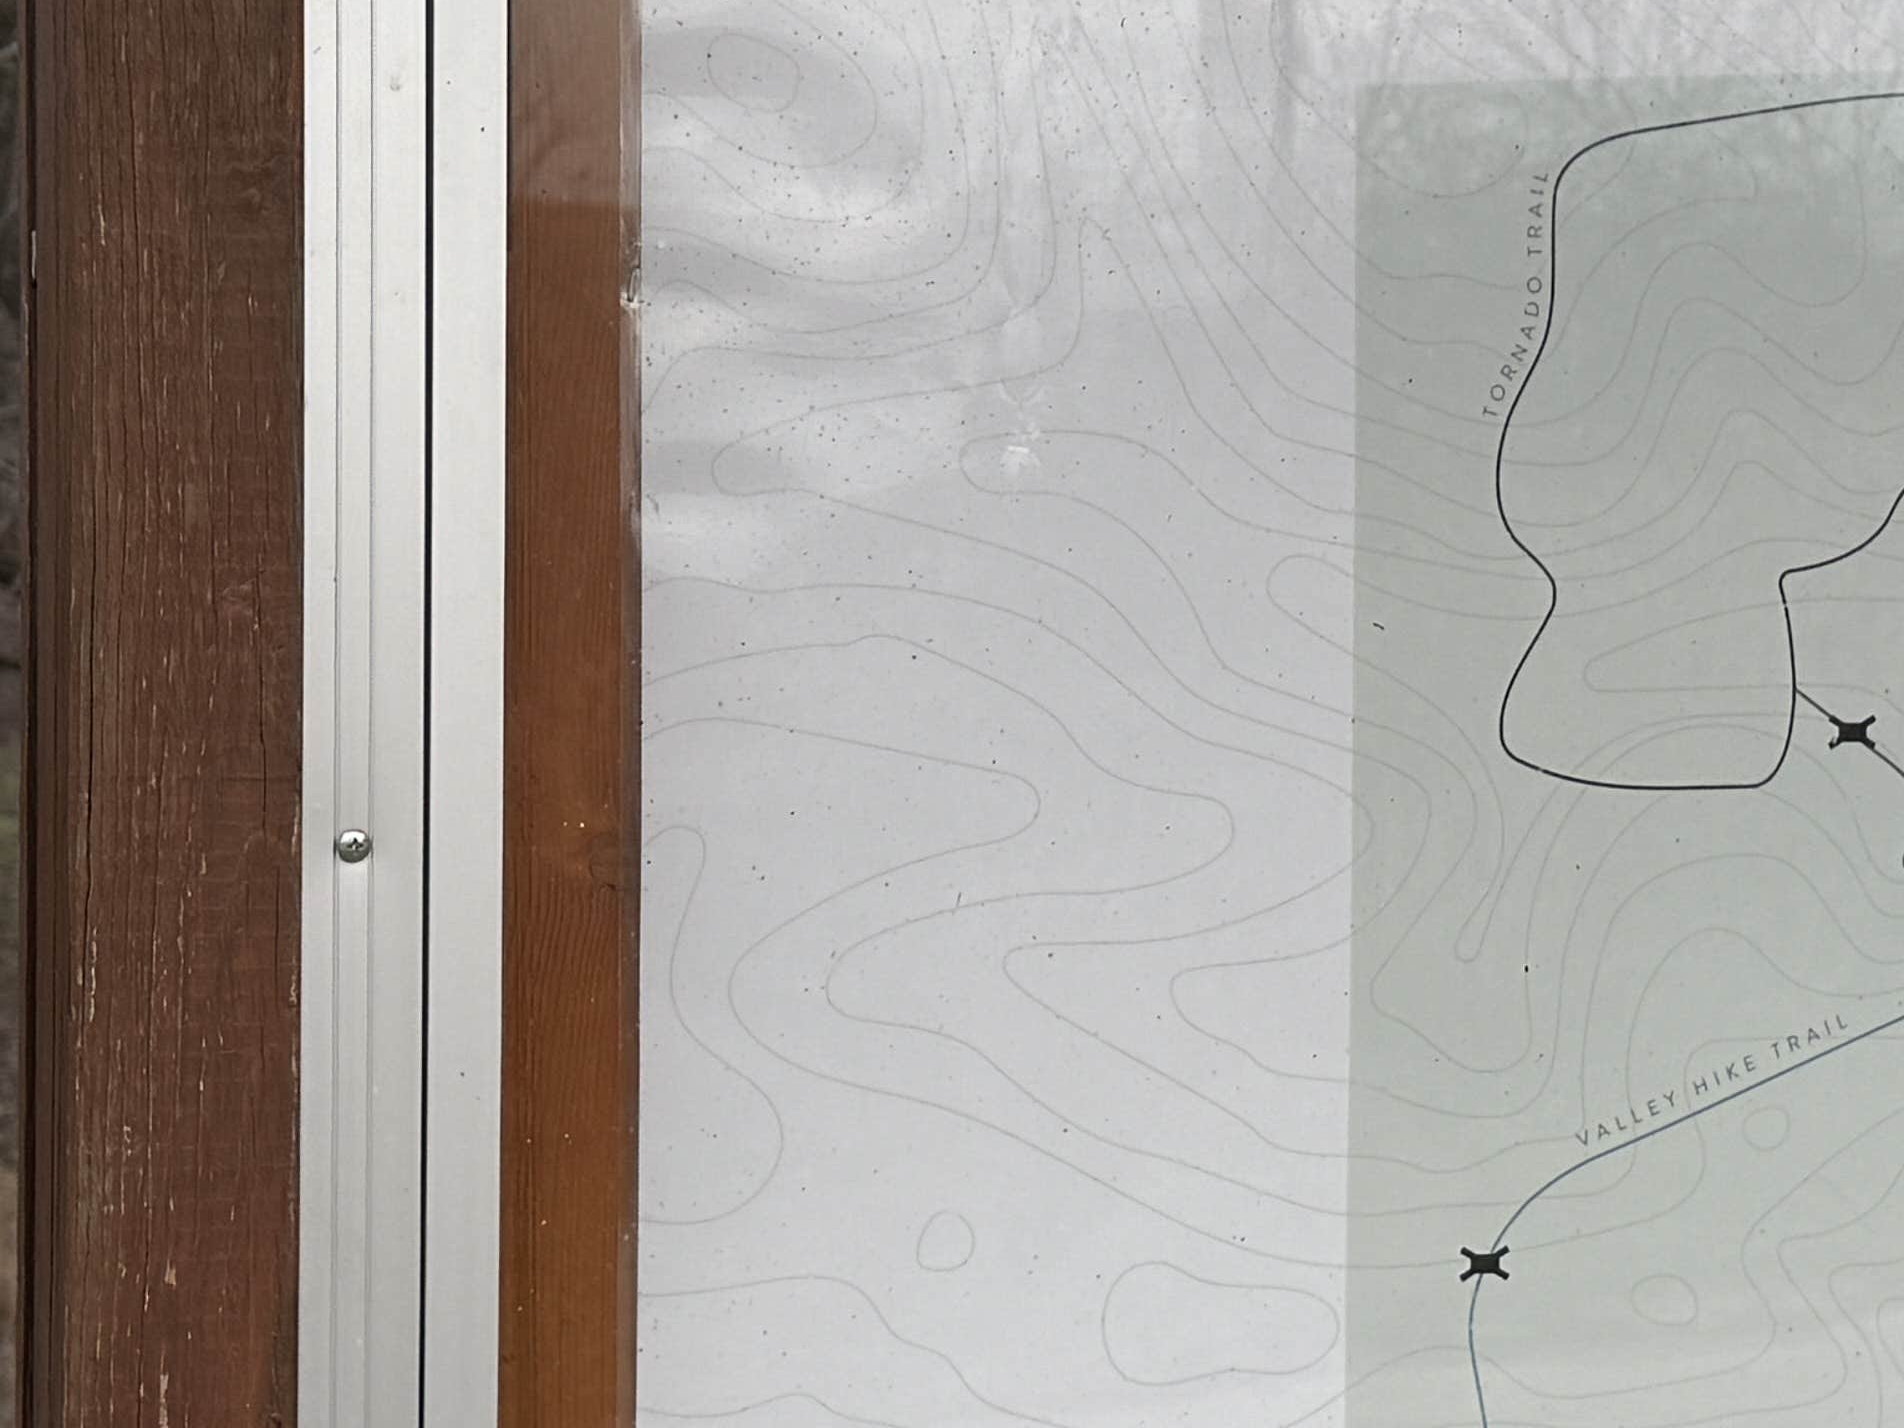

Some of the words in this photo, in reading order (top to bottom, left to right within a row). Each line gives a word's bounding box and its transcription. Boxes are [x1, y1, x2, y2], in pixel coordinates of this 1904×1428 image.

[1482, 276, 1543, 418] TORNADO
[1527, 172, 1549, 257] TRAIL
[1575, 1090, 1677, 1146] VALLEY
[1693, 1054, 1757, 1095] HIKE
[1771, 1014, 1849, 1059] TRAIL
